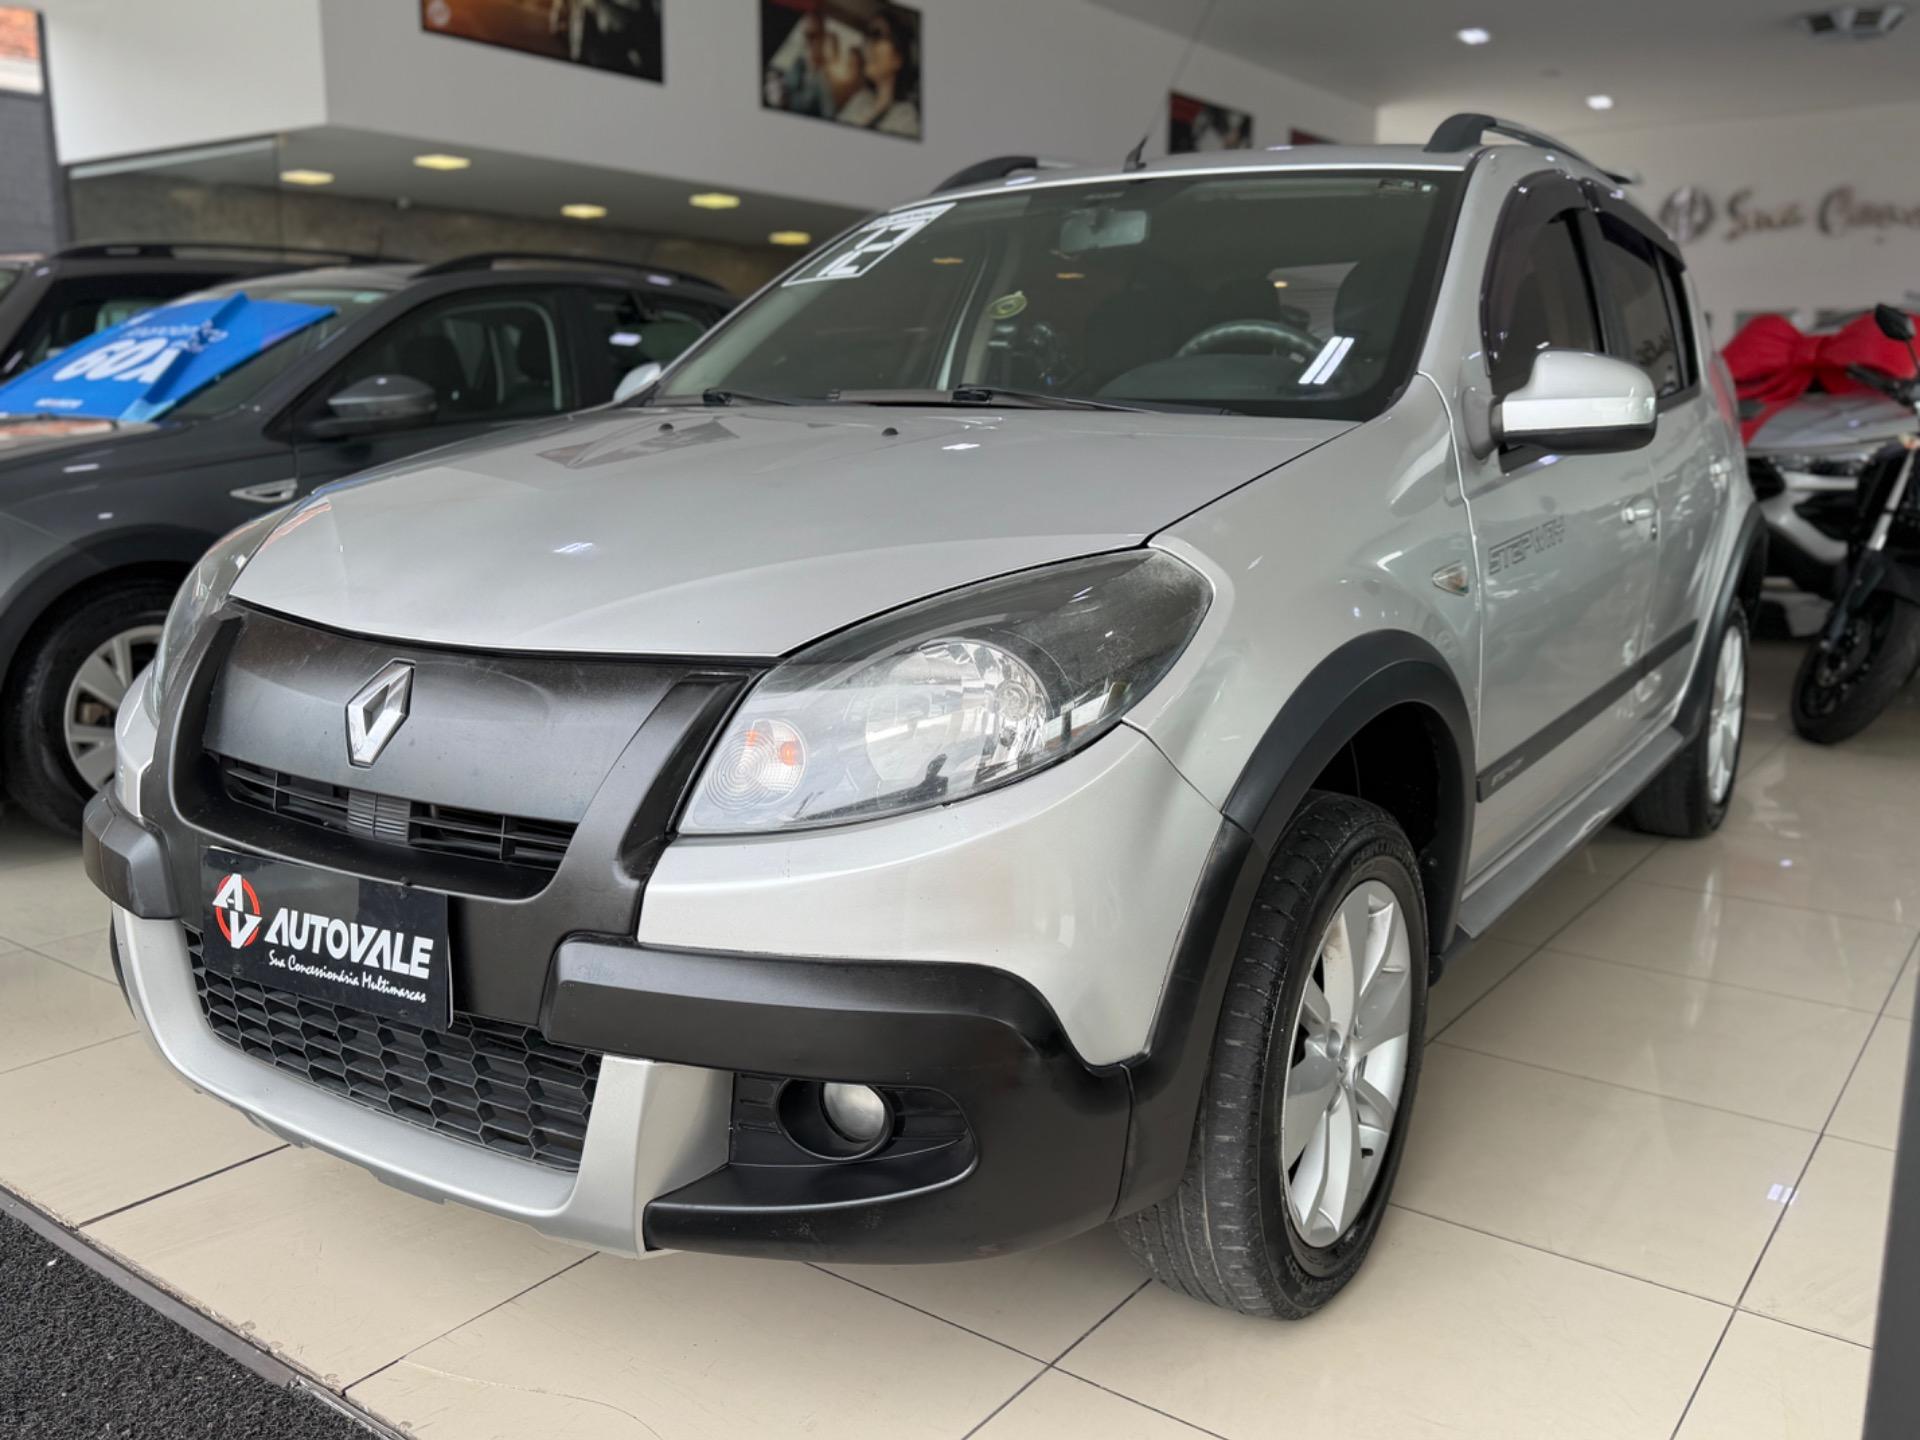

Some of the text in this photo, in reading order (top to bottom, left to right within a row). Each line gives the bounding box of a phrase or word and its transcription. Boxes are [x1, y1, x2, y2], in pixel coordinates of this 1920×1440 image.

[1487, 516, 1564, 576] STEPWAY
[264, 907, 434, 979] AUTOVALE
[268, 949, 427, 1003] Sua Concessionária Multimarcas
